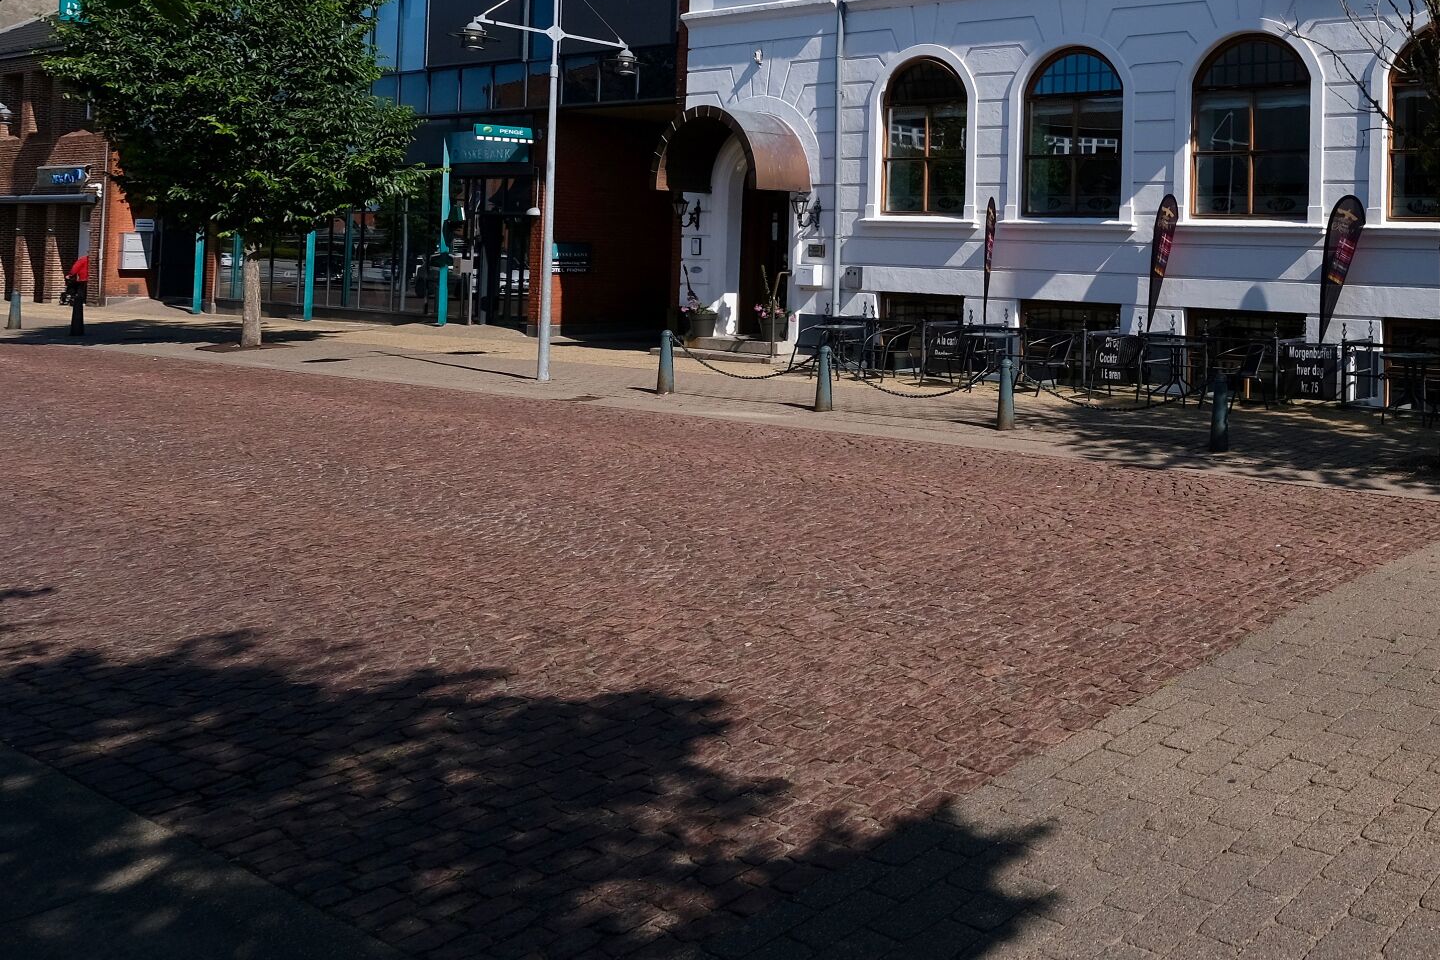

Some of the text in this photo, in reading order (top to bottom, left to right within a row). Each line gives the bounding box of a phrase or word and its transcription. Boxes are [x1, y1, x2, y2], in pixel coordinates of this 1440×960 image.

[499, 128, 524, 136] PENGE
[1296, 364, 1324, 379] hver dag
[1311, 382, 1319, 393] 75
